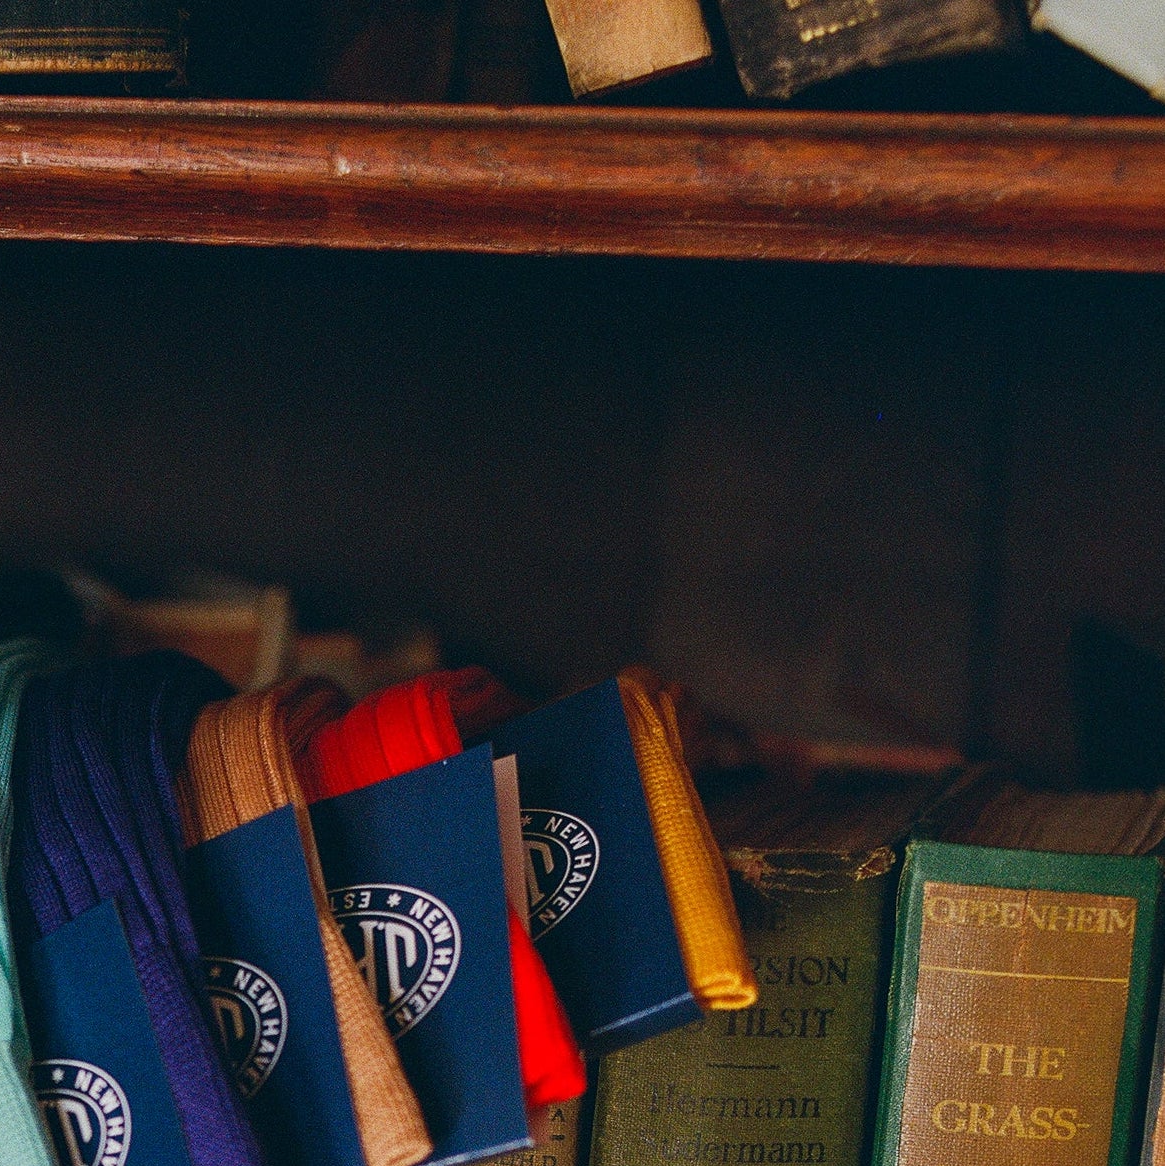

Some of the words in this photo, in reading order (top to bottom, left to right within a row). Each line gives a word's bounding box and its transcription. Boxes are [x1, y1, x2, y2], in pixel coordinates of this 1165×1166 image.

[545, 815, 590, 851] NEW
[538, 853, 591, 925] HAVEN
[409, 898, 453, 943] NEW
[925, 896, 1136, 934] OPPENHEIM
[234, 968, 279, 1013] NEW
[395, 946, 453, 1026] HAVEN
[722, 1006, 835, 1038] TILSIT
[970, 1042, 1066, 1081] THE
[74, 1068, 121, 1114] NEW
[932, 1098, 1090, 1141] GRASS-
